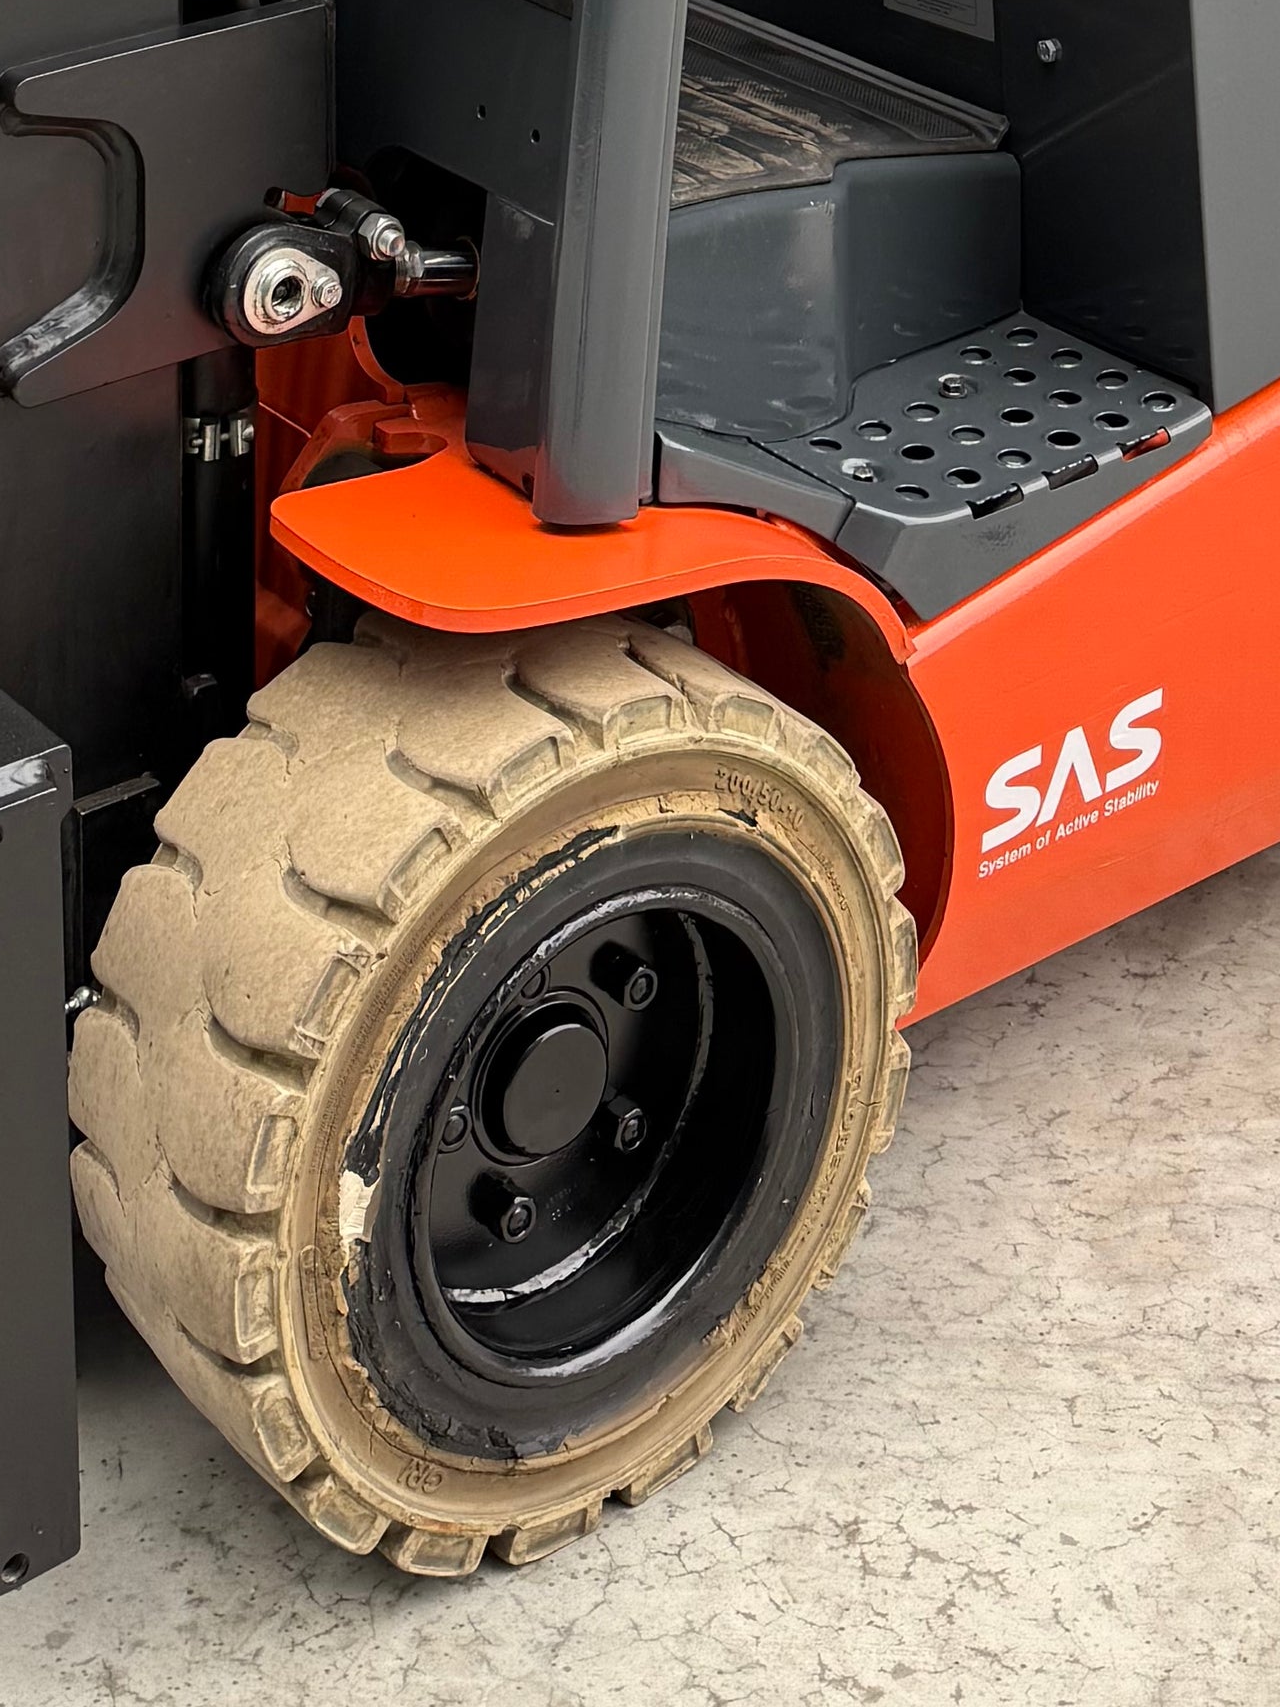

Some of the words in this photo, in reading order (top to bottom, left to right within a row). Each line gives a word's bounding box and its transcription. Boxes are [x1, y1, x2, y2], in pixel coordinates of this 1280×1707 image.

[978, 840, 1032, 878] System
[1036, 830, 1051, 851] of
[1055, 810, 1099, 841] Active
[1104, 780, 1160, 818] Stability
[981, 687, 1163, 854] SAS
